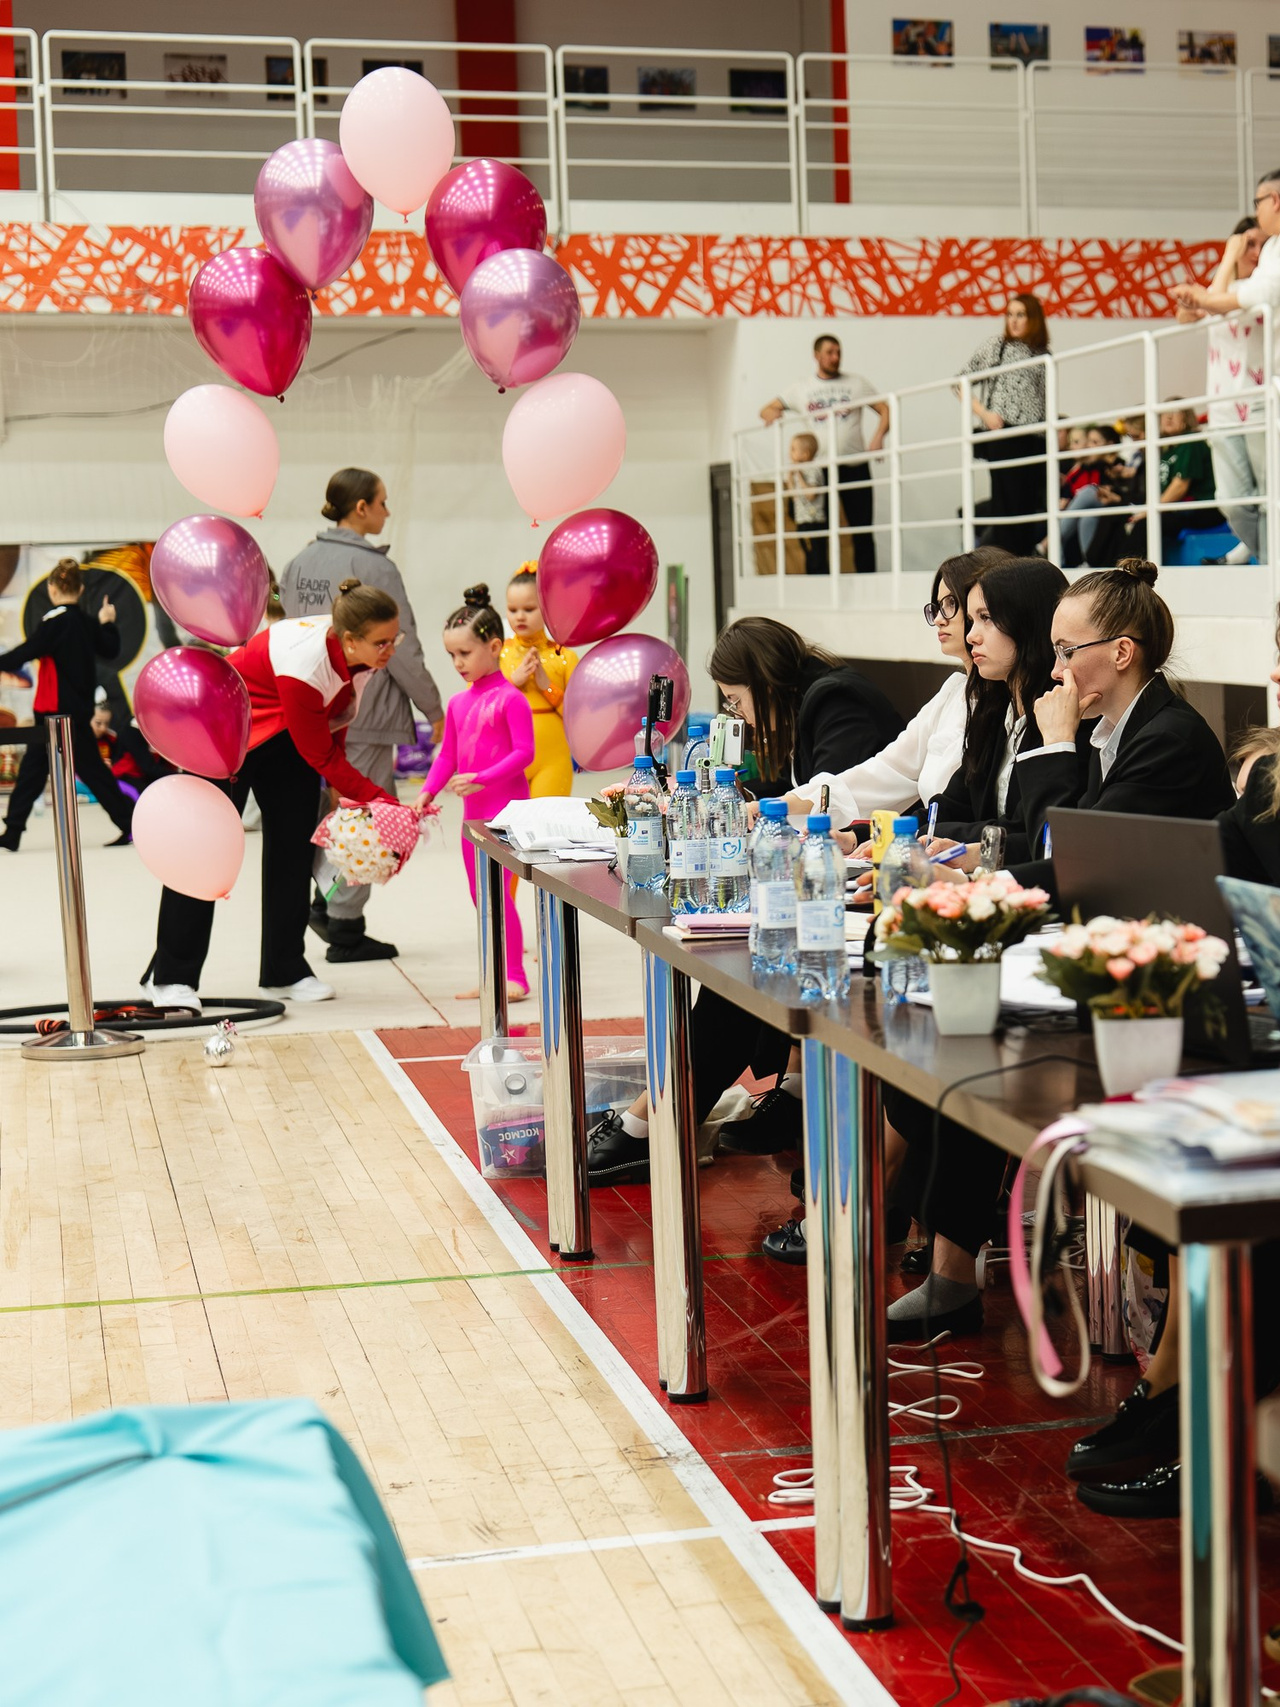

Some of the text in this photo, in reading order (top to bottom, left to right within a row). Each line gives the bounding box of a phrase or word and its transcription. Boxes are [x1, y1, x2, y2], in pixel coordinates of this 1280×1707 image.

[296, 566, 333, 603] LEADER
[298, 591, 326, 613] SHOW
[498, 1127, 540, 1141] КОСМОС
